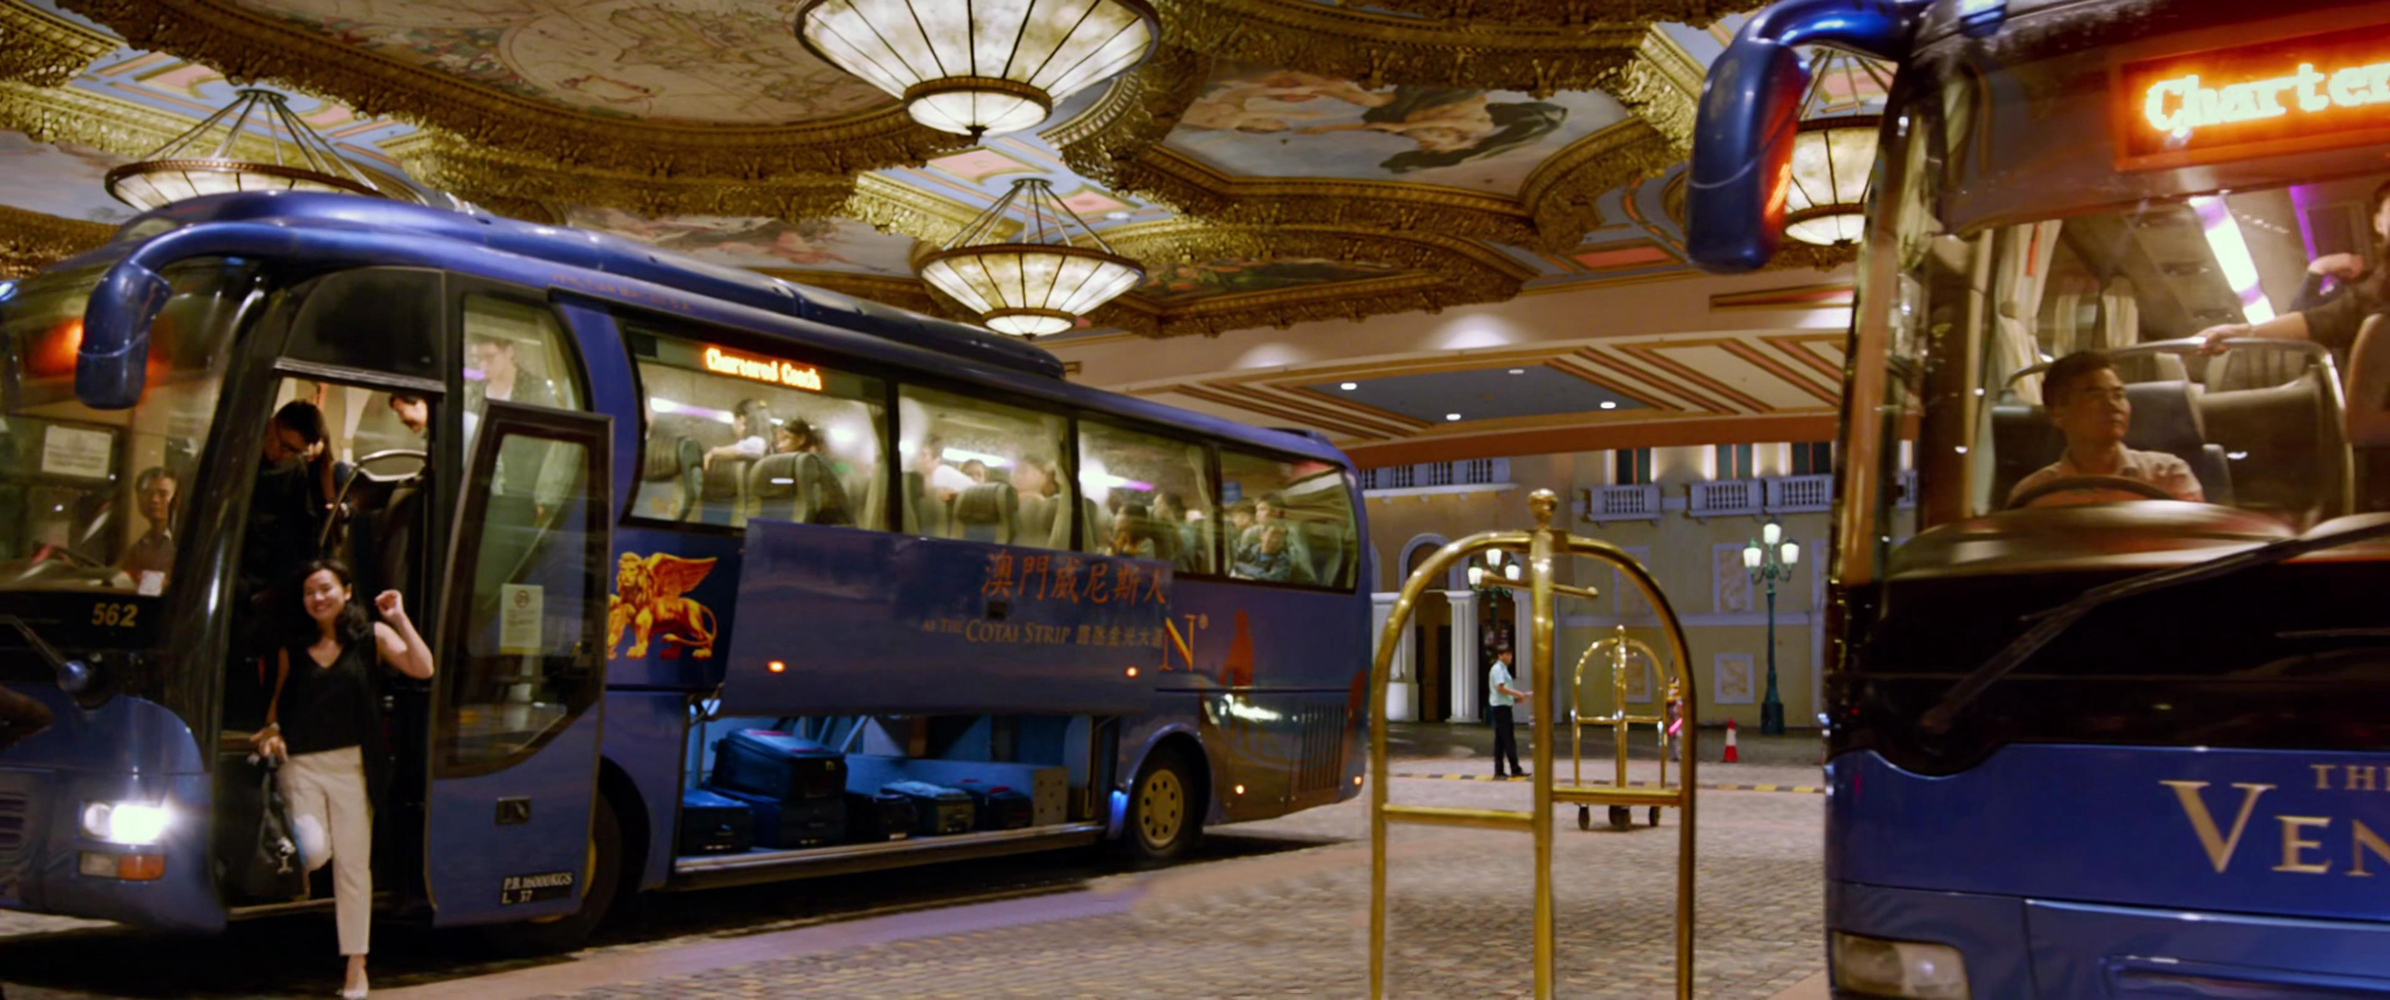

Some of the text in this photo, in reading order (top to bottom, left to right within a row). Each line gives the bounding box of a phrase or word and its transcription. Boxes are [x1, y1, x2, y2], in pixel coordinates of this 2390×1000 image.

[981, 549, 1166, 604] 澳門威尼斯人
[92, 602, 139, 627] 562
[2309, 763, 2390, 791] TH
